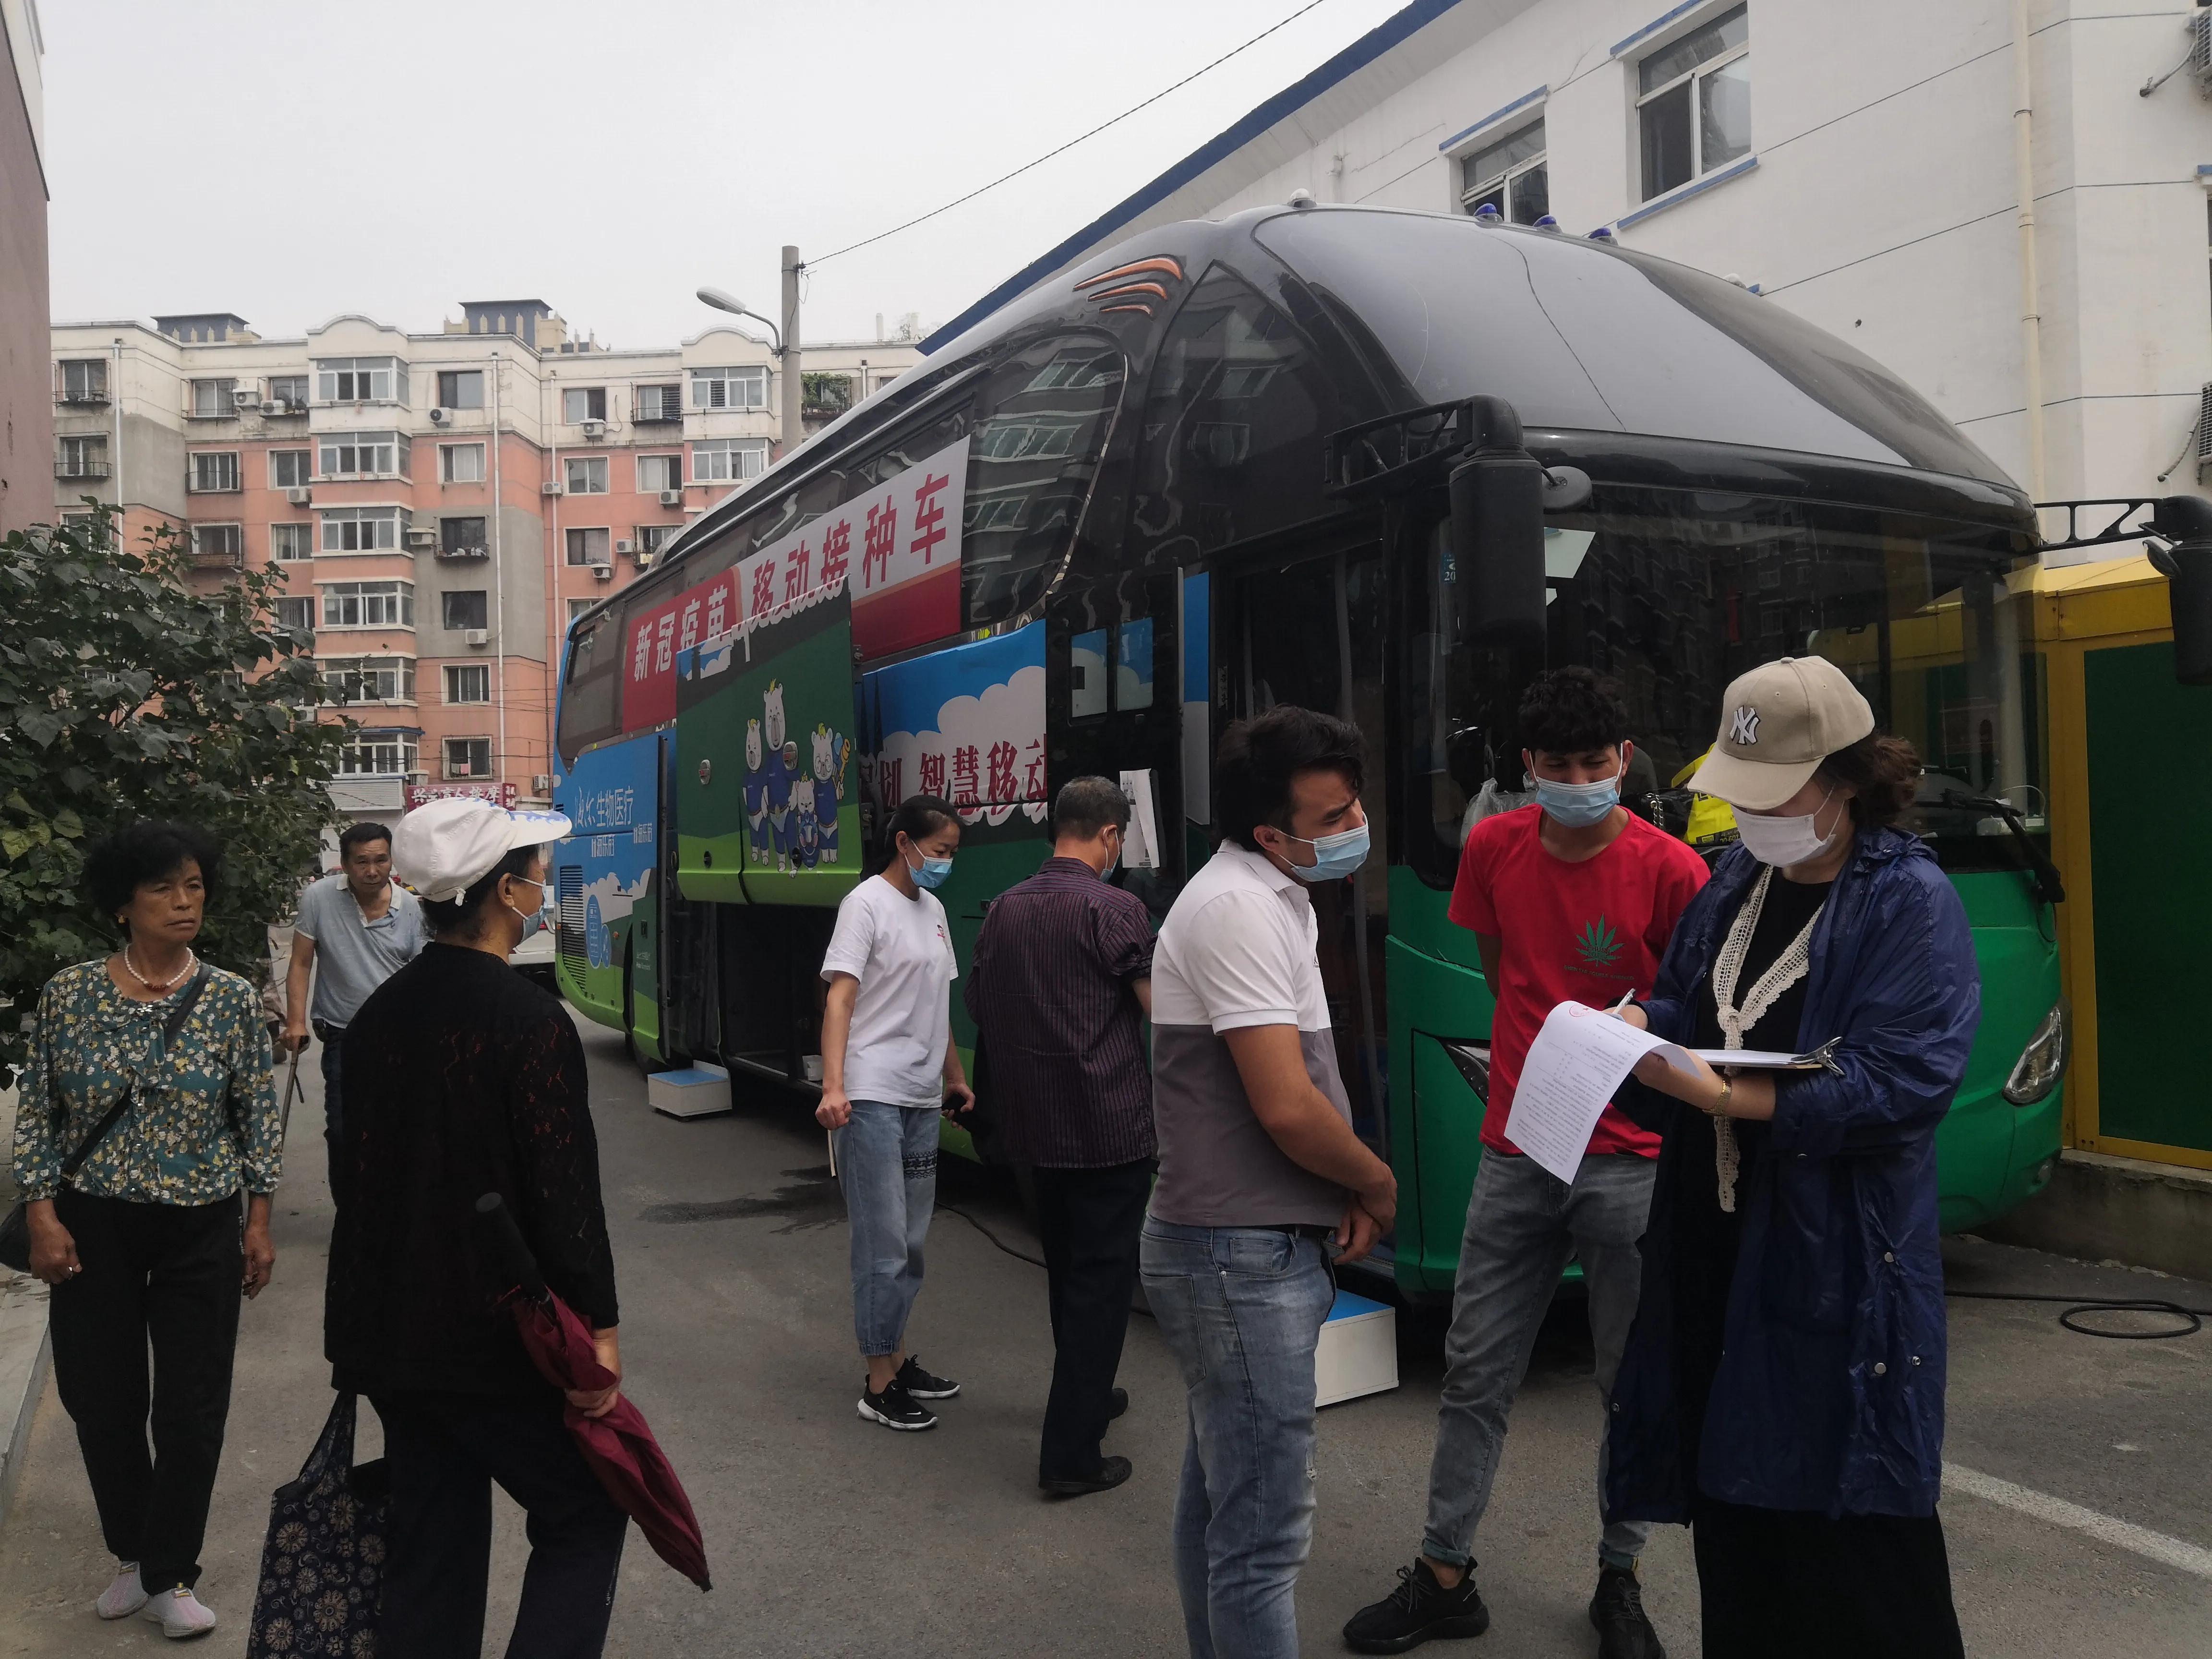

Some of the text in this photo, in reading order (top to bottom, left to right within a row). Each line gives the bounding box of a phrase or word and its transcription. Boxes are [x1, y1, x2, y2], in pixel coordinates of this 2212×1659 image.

[635, 473, 950, 682] 新冠疫苗 移动接种车
[1730, 705, 1761, 745] NY
[575, 785, 634, 829] 海尔生物医疗
